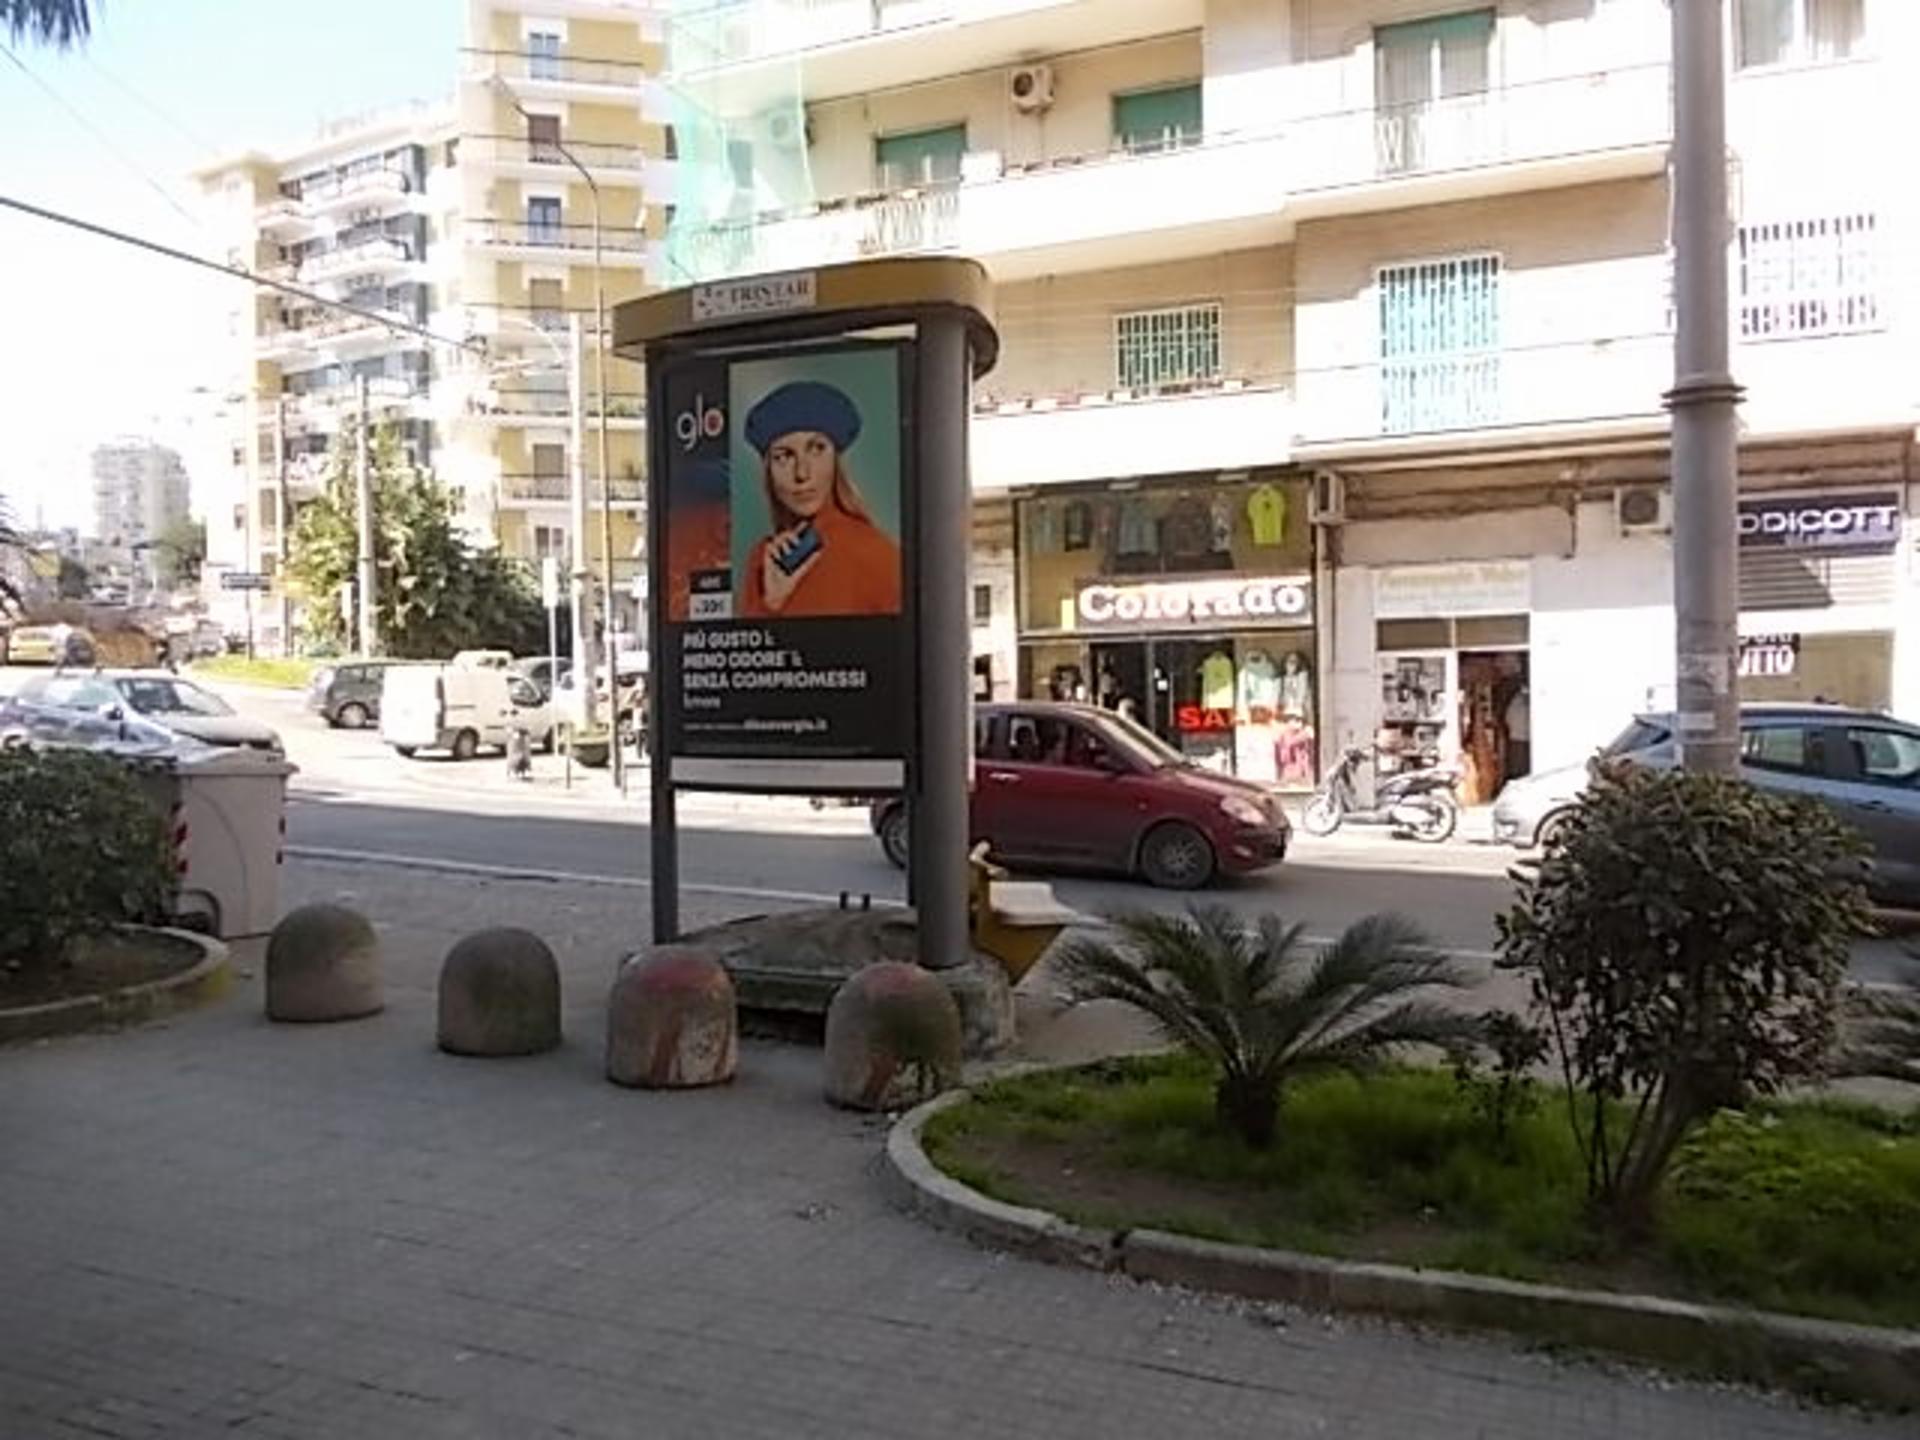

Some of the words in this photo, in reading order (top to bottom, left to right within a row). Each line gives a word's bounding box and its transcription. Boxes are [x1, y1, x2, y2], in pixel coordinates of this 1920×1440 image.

[678, 393, 724, 450] glo
[1079, 583, 1306, 621] Colorado
[708, 631, 763, 648] GUSTO
[683, 652, 726, 669] MENO
[683, 670, 729, 688] SENZA
[733, 670, 866, 688] COMPROMESSI
